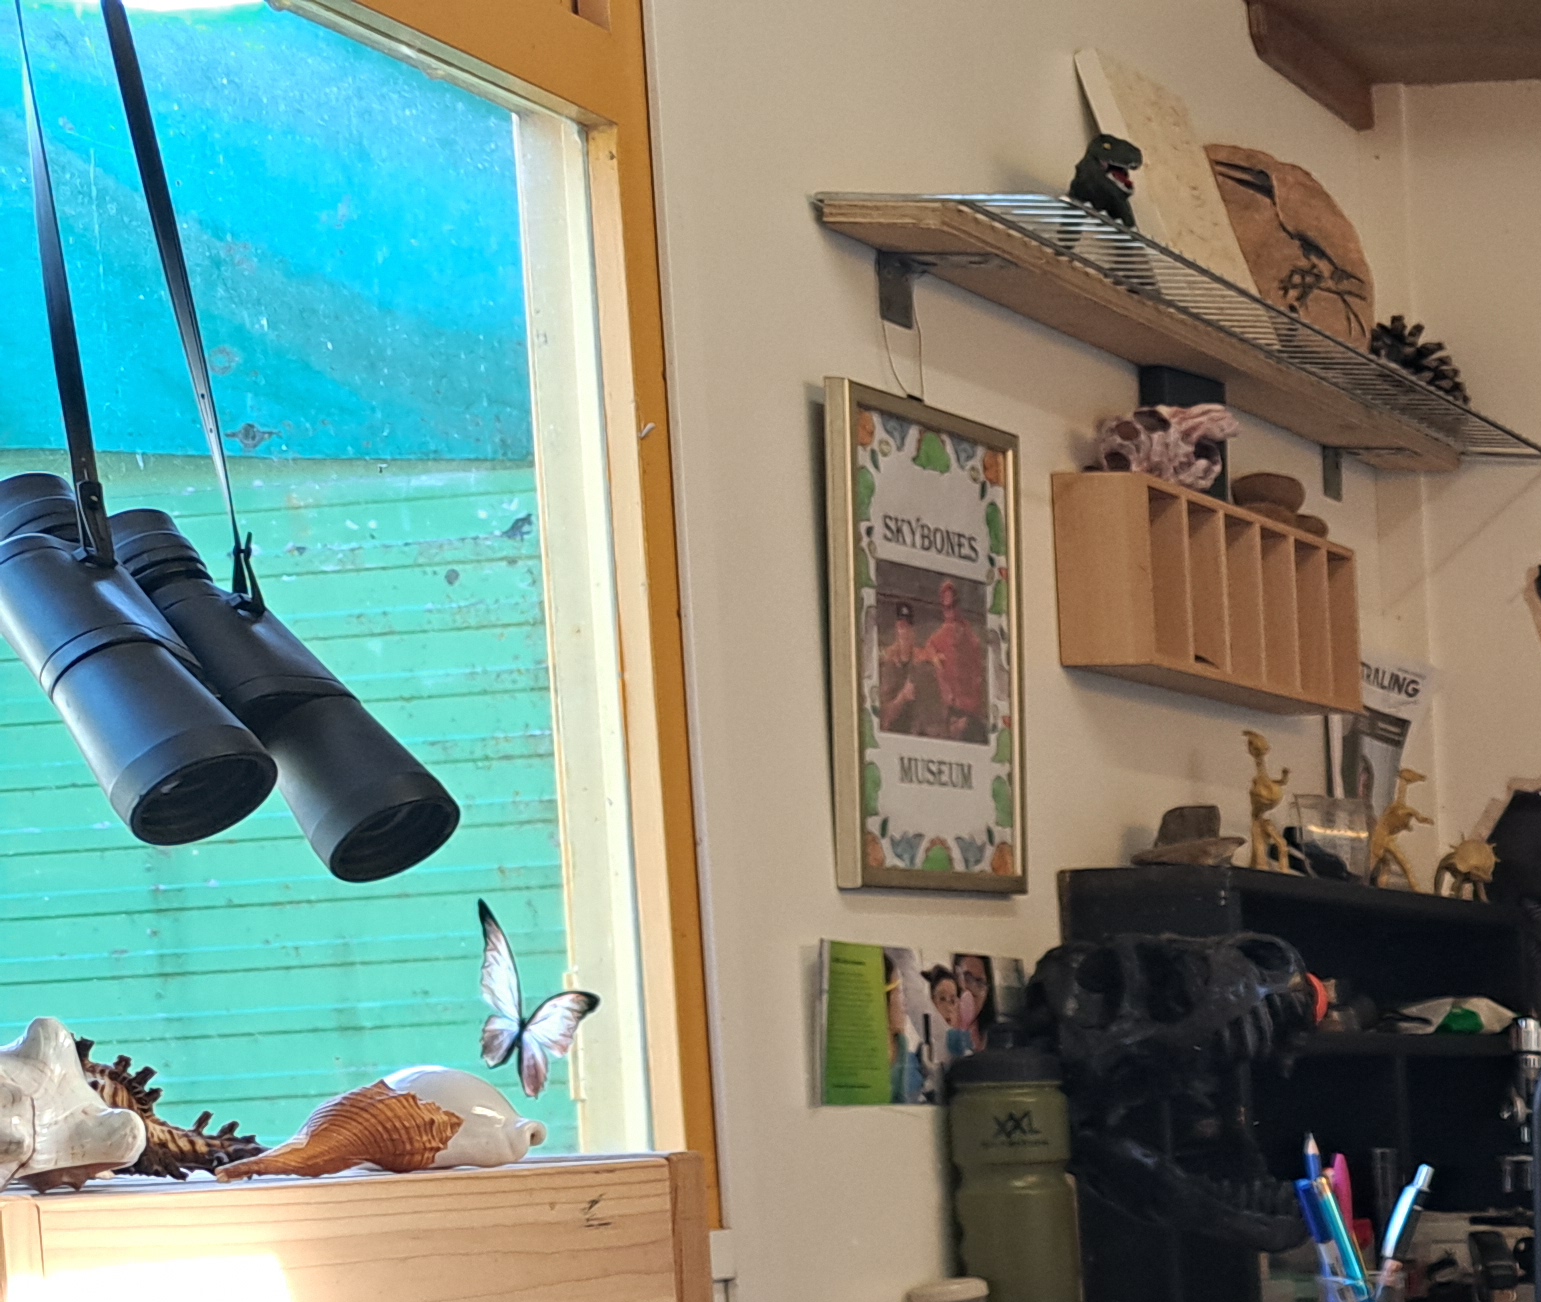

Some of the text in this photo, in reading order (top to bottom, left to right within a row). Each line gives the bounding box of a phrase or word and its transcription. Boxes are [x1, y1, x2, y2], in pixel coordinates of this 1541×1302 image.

[882, 514, 978, 562] SKYBONES
[899, 756, 974, 790] MUSEUM
[993, 1109, 1042, 1138] XXL
